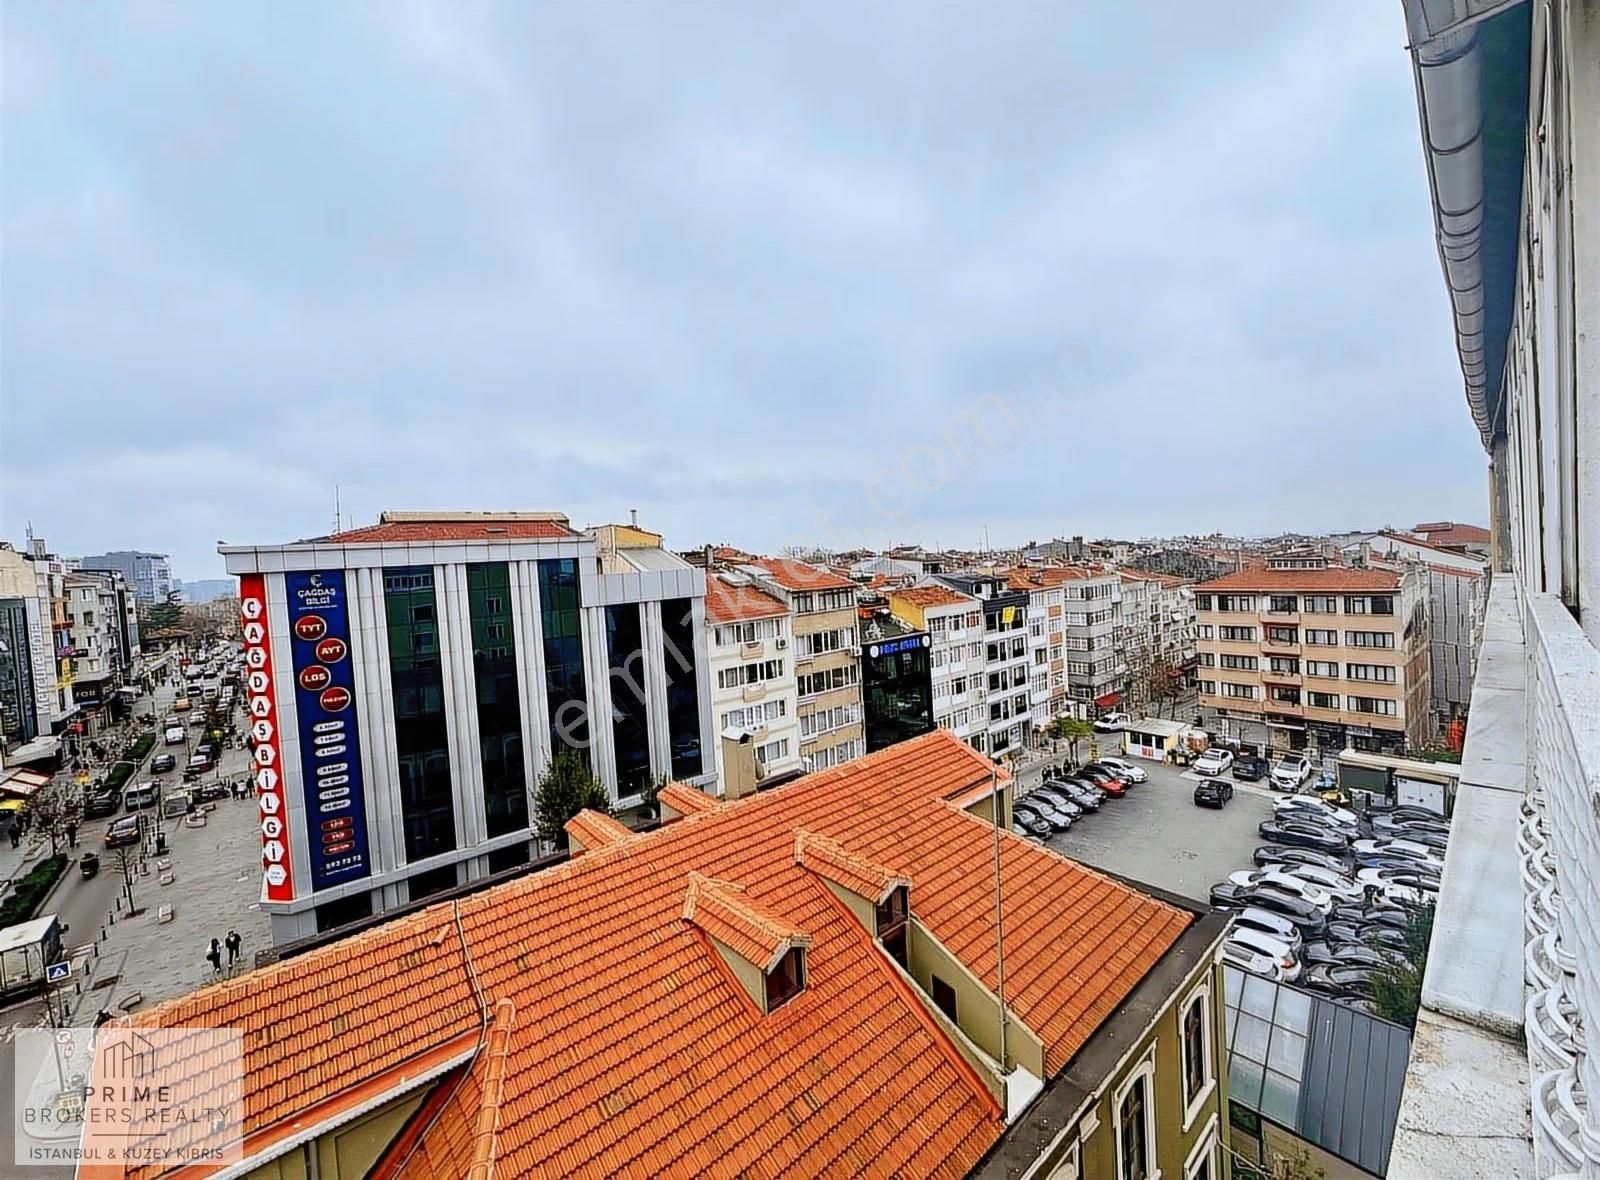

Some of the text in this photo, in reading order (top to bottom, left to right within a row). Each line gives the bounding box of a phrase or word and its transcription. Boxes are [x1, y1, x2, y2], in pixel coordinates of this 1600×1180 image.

[300, 623, 322, 632] TYT
[321, 645, 341, 655] AYT
[246, 601, 267, 740] ÇAĞDAŞ
[260, 749, 277, 860] BİLGİ
